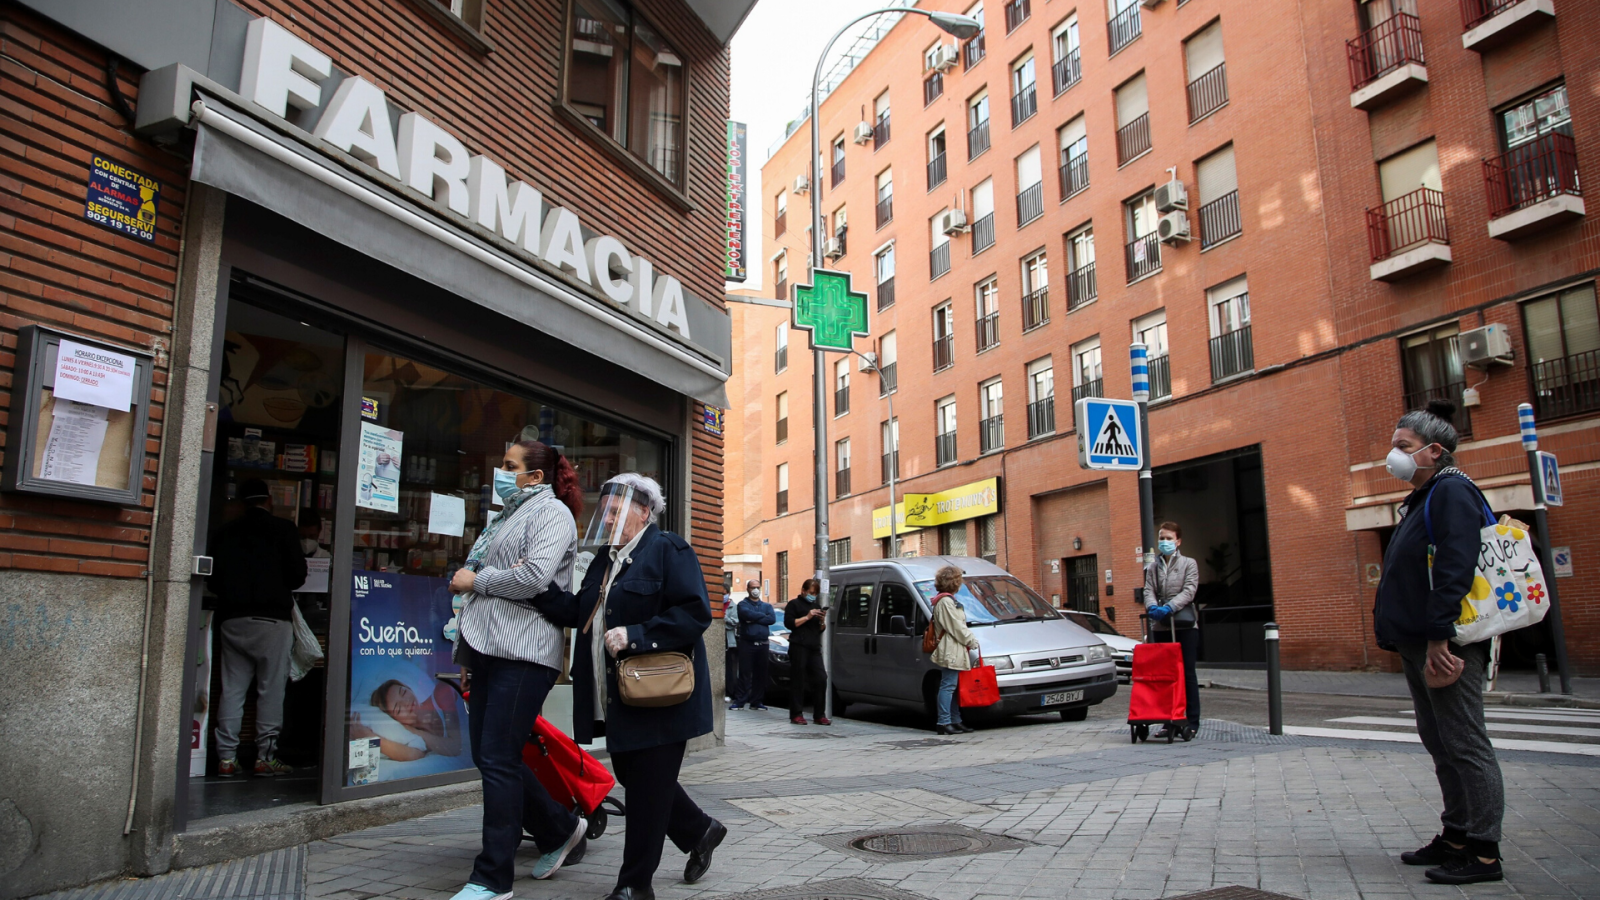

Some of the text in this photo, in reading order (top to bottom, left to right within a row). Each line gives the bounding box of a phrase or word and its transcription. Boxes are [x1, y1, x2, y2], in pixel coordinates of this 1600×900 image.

[729, 141, 741, 167] LOS
[94, 157, 159, 192] CONECTADA
[94, 169, 137, 190] CON CENTRAL
[238, 16, 691, 340] FARMACIA
[90, 181, 138, 206] ALARMAS
[87, 210, 152, 240] 902 19 12 00
[88, 202, 154, 234] SEGURSERVI
[74, 349, 124, 366] HORARIO EXCEPCIONAL
[358, 616, 432, 644] Sueña...
[360, 648, 375, 656] con
[378, 645, 386, 656] lo
[388, 648, 402, 658] que
[1046, 692, 1080, 704] 2548 BYJ
